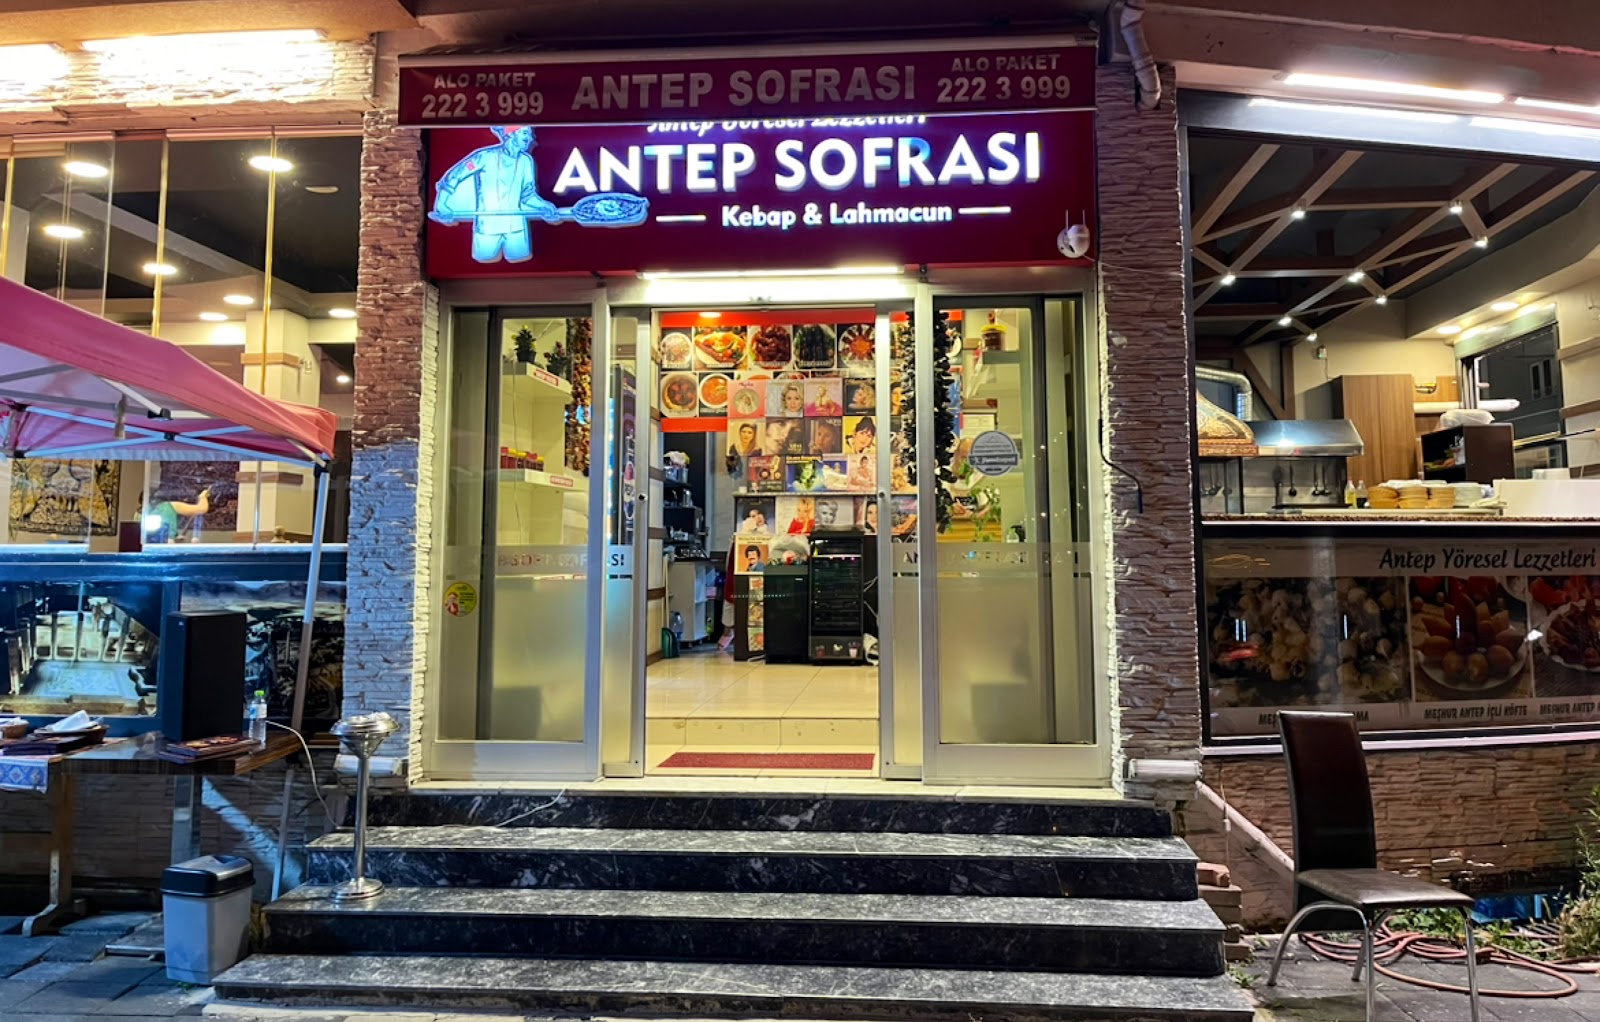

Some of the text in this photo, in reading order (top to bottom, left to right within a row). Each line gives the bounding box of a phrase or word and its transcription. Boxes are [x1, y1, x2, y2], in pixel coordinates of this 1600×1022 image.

[951, 54, 1061, 72] ALO PAKET
[434, 72, 536, 89] ALO PAKET
[571, 65, 915, 111] ANTEP SOFRASI
[936, 75, 1071, 104] 222 3 999
[422, 91, 544, 118] 222 3 999
[552, 132, 1040, 194] ANTEP SOFRASI
[722, 201, 952, 230] Kebap & Lahmacun
[1379, 547, 1596, 573] Antep Yöresel Lezzetleri
[1459, 706, 1485, 718] ANTEP
[1504, 703, 1527, 716] KÖFTE
